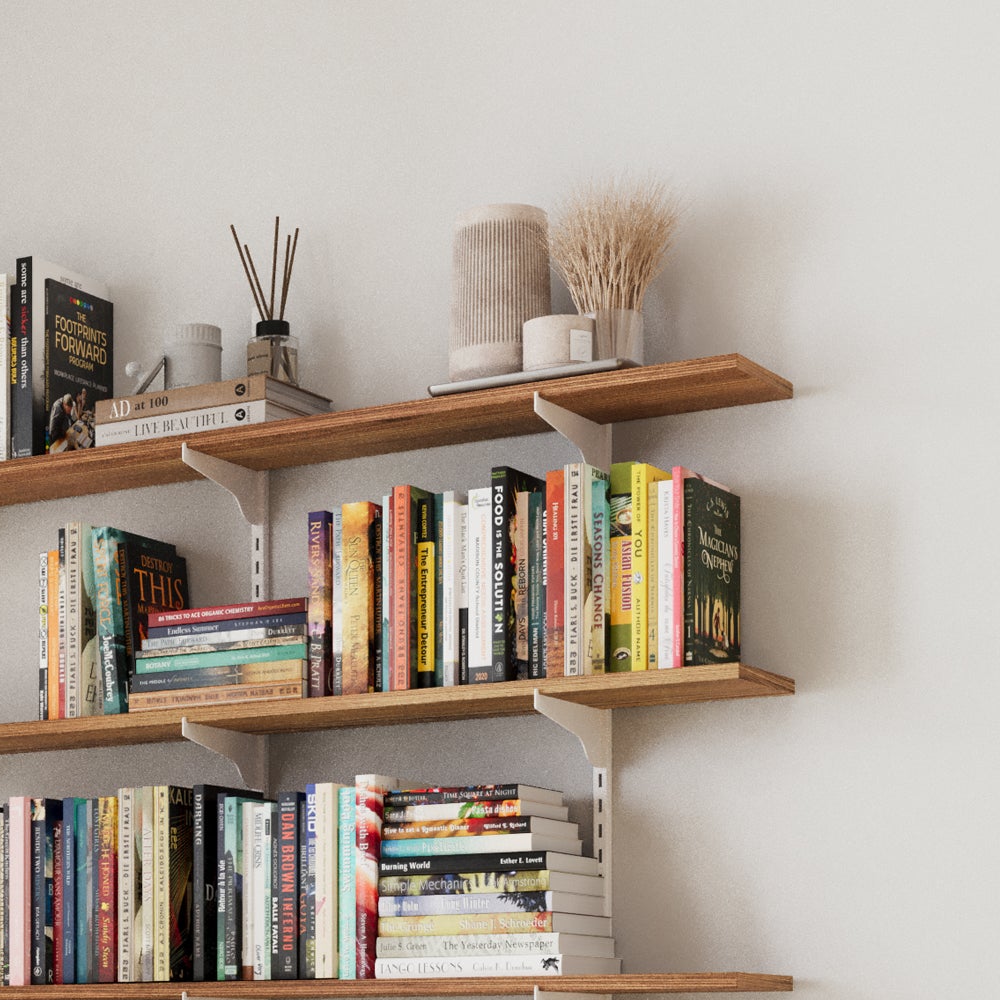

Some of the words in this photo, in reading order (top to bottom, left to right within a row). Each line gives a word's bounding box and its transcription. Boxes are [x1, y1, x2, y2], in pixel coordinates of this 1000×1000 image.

[20, 263, 28, 287] some
[20, 289, 28, 304] are
[20, 306, 28, 336] sicker
[76, 311, 87, 323] THE
[55, 314, 107, 347] FOOTPRINTS
[20, 337, 28, 358] than
[55, 331, 107, 366] FORWARD
[20, 360, 28, 390] others
[68, 355, 94, 372] PROGRAM
[109, 399, 131, 419] AD
[134, 401, 145, 411] at
[149, 396, 169, 408] 100
[135, 421, 161, 437] LIVE
[163, 412, 229, 433] BEAUTIFUL
[494, 485, 503, 526] FOOD
[459, 513, 467, 524] The
[310, 521, 323, 566] RIVERS
[459, 525, 467, 542] Black
[592, 512, 604, 569] SEASONS
[635, 530, 643, 558] YOU
[698, 526, 739, 561] MAGICIAN'S
[94, 538, 107, 577] SPENT
[348, 537, 362, 557] SUN
[419, 547, 429, 566] The
[494, 541, 503, 559] THE
[622, 540, 633, 571] Asian
[141, 555, 173, 574] DESTROY
[517, 558, 527, 596] REBORN
[701, 549, 735, 580] NEPHEW
[133, 568, 184, 610] THIS
[346, 559, 362, 597] QUEEN
[98, 583, 111, 626] FORCE
[419, 569, 429, 631] Entrepreneur
[592, 573, 604, 630] CHANGE
[622, 574, 633, 611] Fusion
[201, 609, 225, 617] ORGANIC
[225, 606, 254, 614] CHEMISTRY
[167, 627, 191, 635] Endless
[517, 618, 527, 641] DAYS
[419, 632, 429, 666] Detour
[145, 661, 171, 669] BOTANY
[310, 655, 323, 691] PRATT
[443, 791, 458, 799] TIME
[459, 790, 483, 799] SQUARE
[495, 788, 517, 796] NIGHT
[307, 793, 316, 832] SKID
[282, 813, 295, 840] DAN
[143, 828, 152, 869] AFTER
[218, 860, 226, 871] vie
[282, 845, 295, 893] BROWN
[381, 863, 408, 872] Burning
[409, 861, 431, 869] World
[143, 871, 152, 903] DAYS
[382, 879, 416, 893] Simple
[218, 888, 226, 913] Retour
[462, 897, 490, 908] Winter
[102, 916, 111, 944] Sandy
[282, 897, 295, 952] INFERNO
[358, 913, 368, 934] Steven
[459, 920, 488, 930] Shane
[499, 917, 548, 928] Schroeder
[102, 946, 111, 968] Steen
[406, 943, 427, 951] Green
[443, 941, 459, 950] The
[460, 940, 503, 951] Yesterday
[506, 938, 553, 950] Newspaper
[380, 963, 414, 974] TANGO
[418, 962, 463, 973] LESSONS
